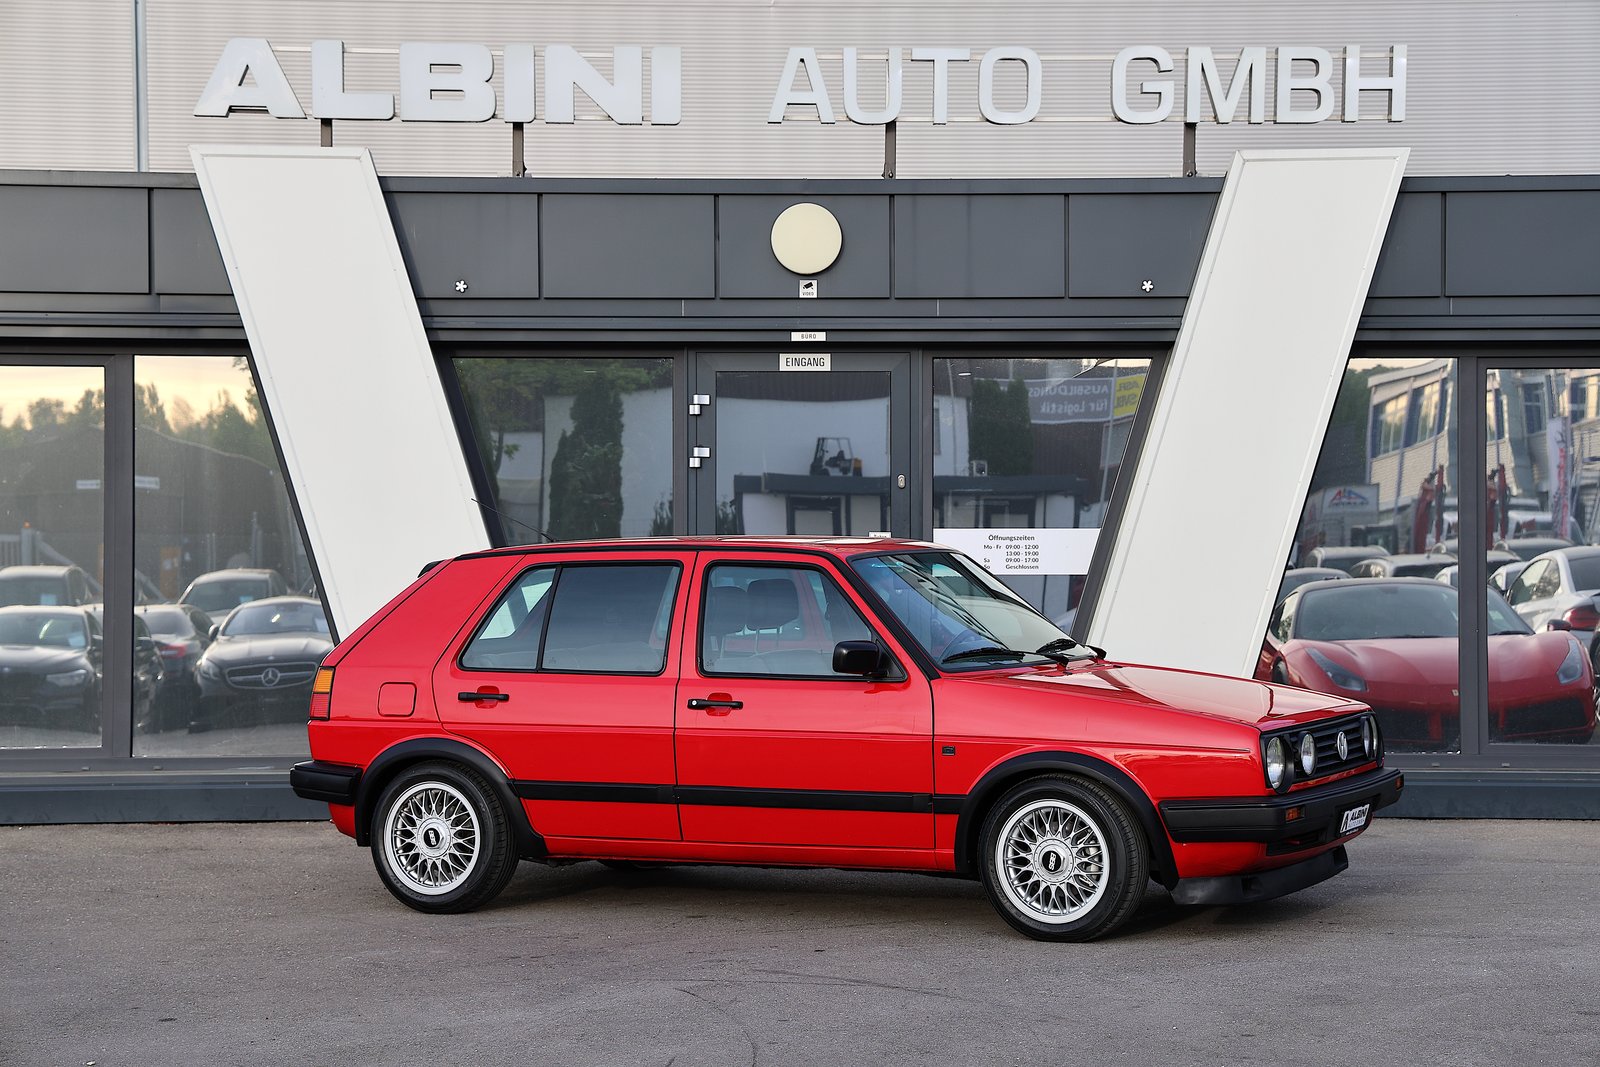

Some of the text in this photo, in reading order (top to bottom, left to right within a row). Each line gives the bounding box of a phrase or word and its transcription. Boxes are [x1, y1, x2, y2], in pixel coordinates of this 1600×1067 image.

[193, 37, 1408, 126] ALBINI AUTO GMBH
[785, 357, 825, 367] EINGANG
[988, 534, 1035, 542] Öffnungszeiten
[1048, 851, 1057, 870] BBS
